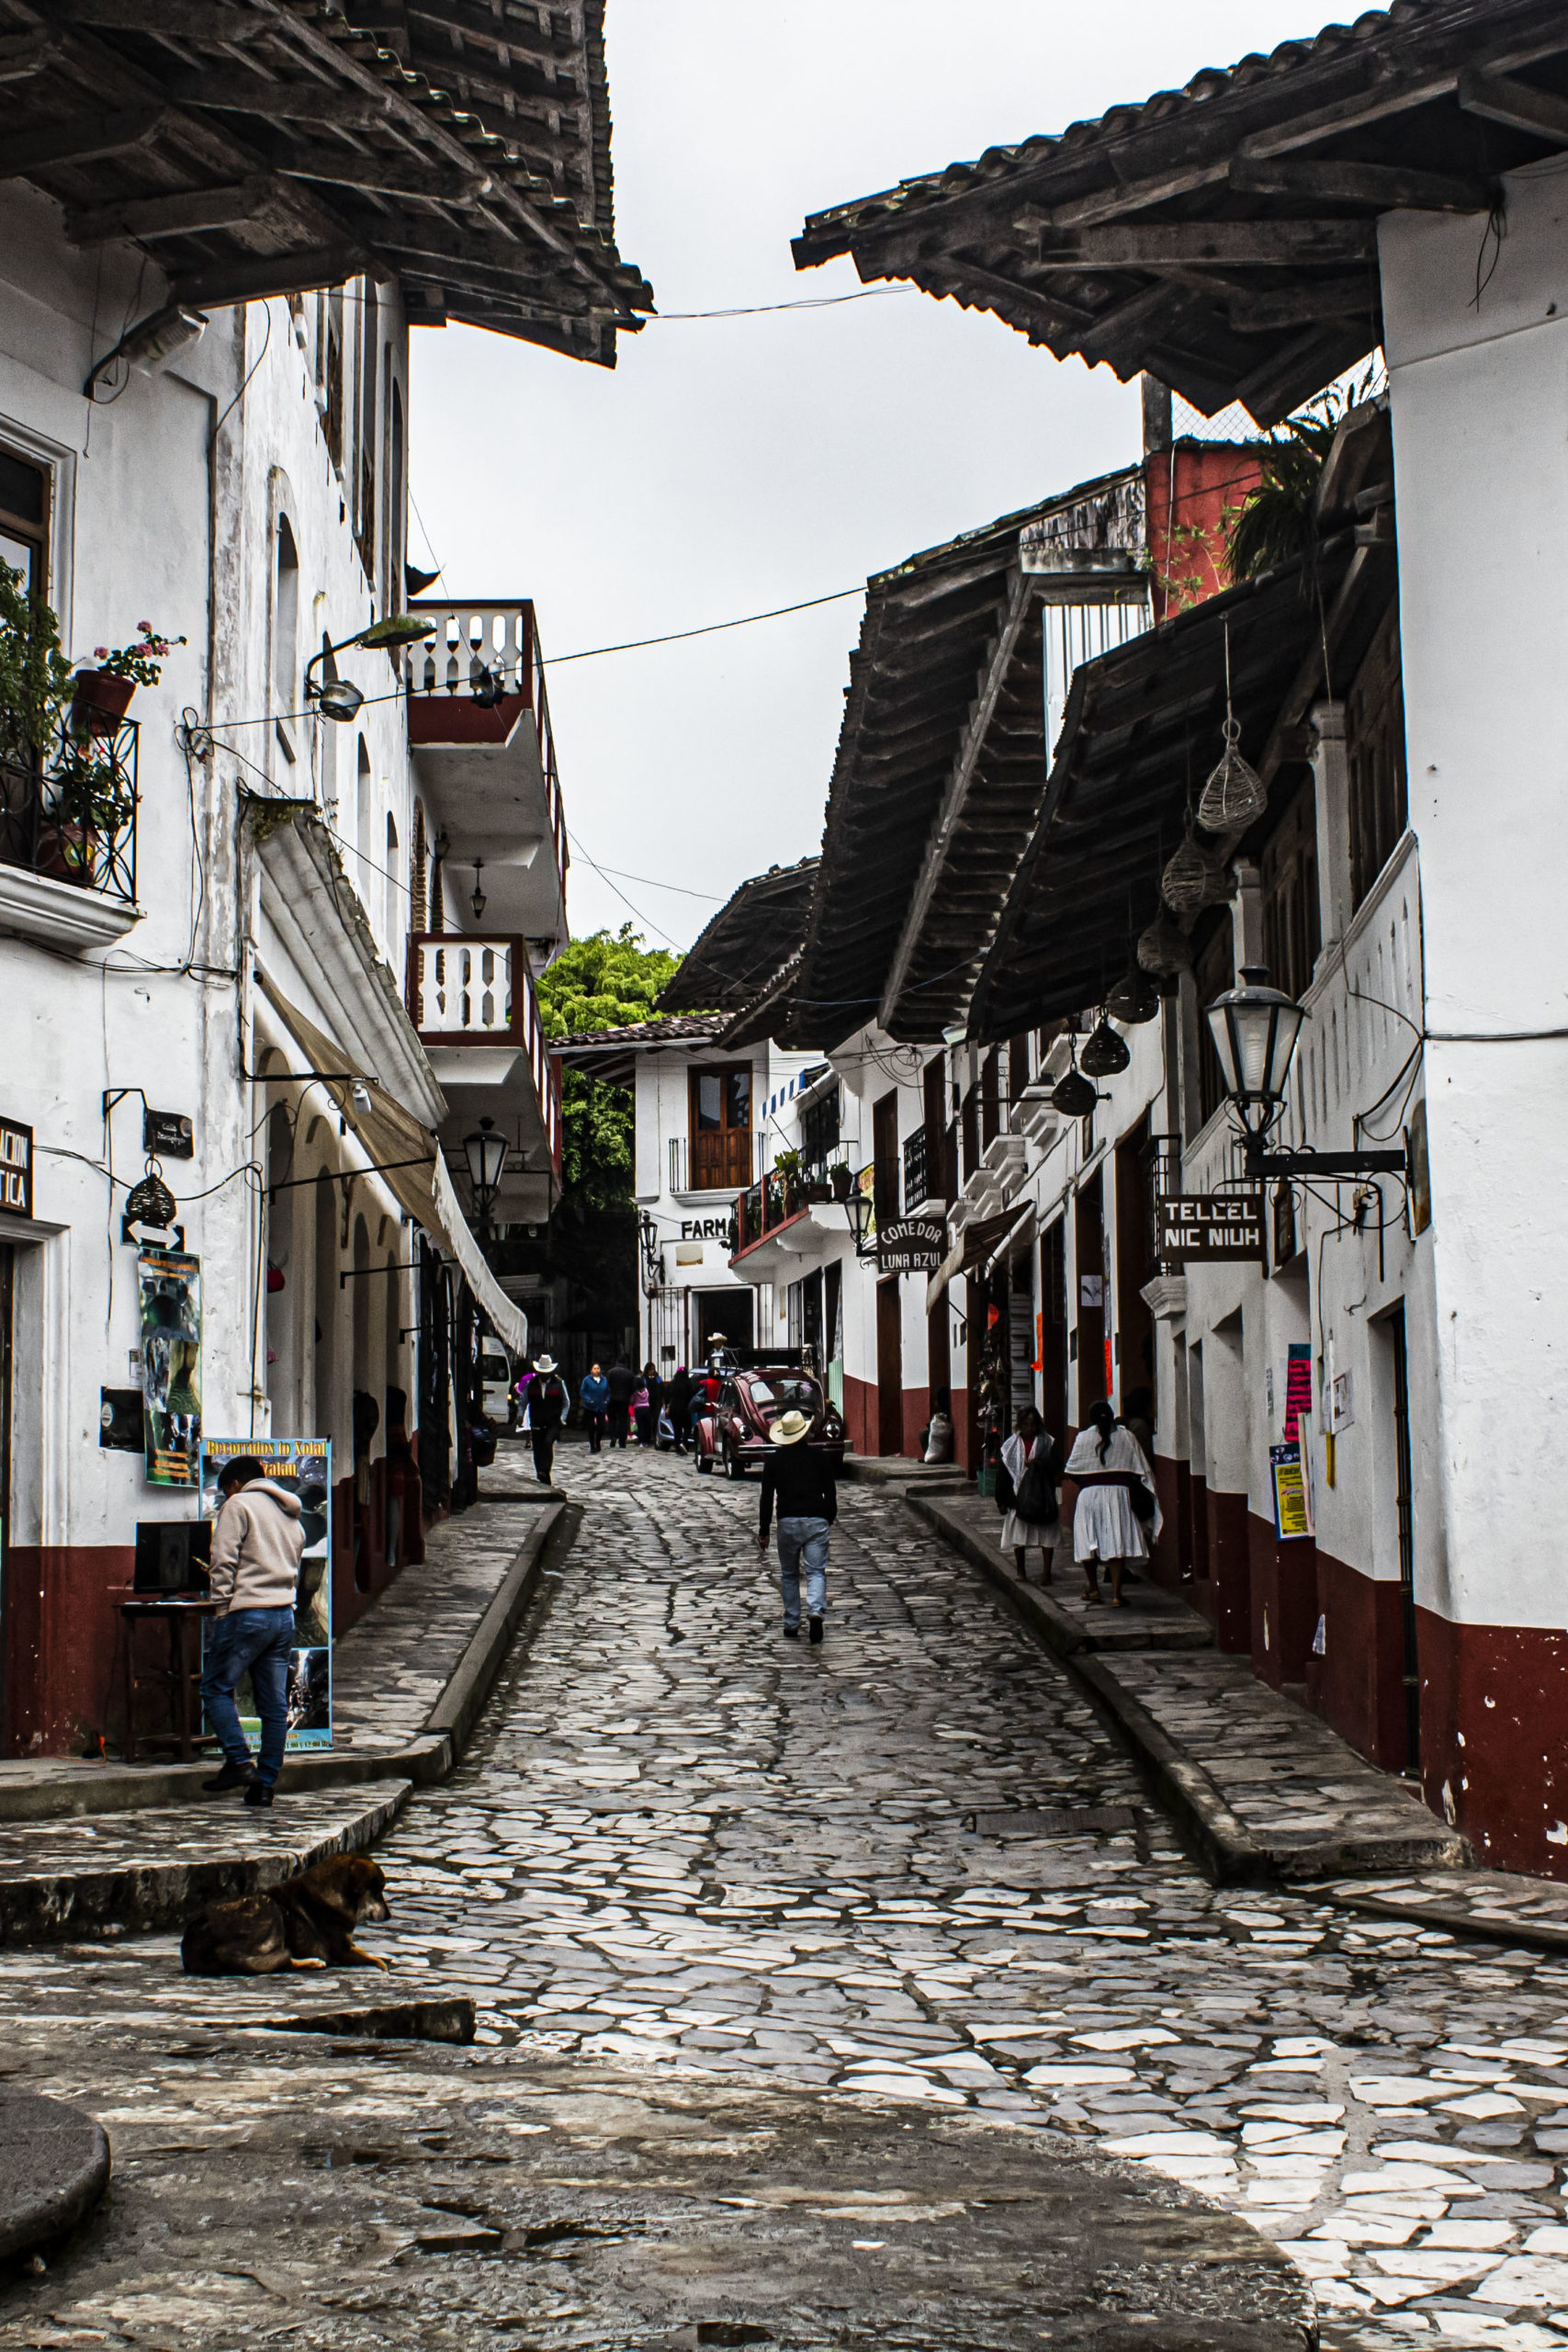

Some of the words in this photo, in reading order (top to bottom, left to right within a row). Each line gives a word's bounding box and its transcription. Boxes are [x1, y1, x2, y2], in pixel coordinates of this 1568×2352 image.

[1165, 1202, 1258, 1221] TELCEL
[681, 1218, 727, 1239] FARM
[881, 1221, 942, 1245] COMEDOR
[1165, 1228, 1201, 1247] NIC
[1208, 1227, 1259, 1247] NIUH
[882, 1253, 910, 1269] LUNA
[913, 1251, 943, 1267] AZUL
[206, 1440, 275, 1456] Recorridos
